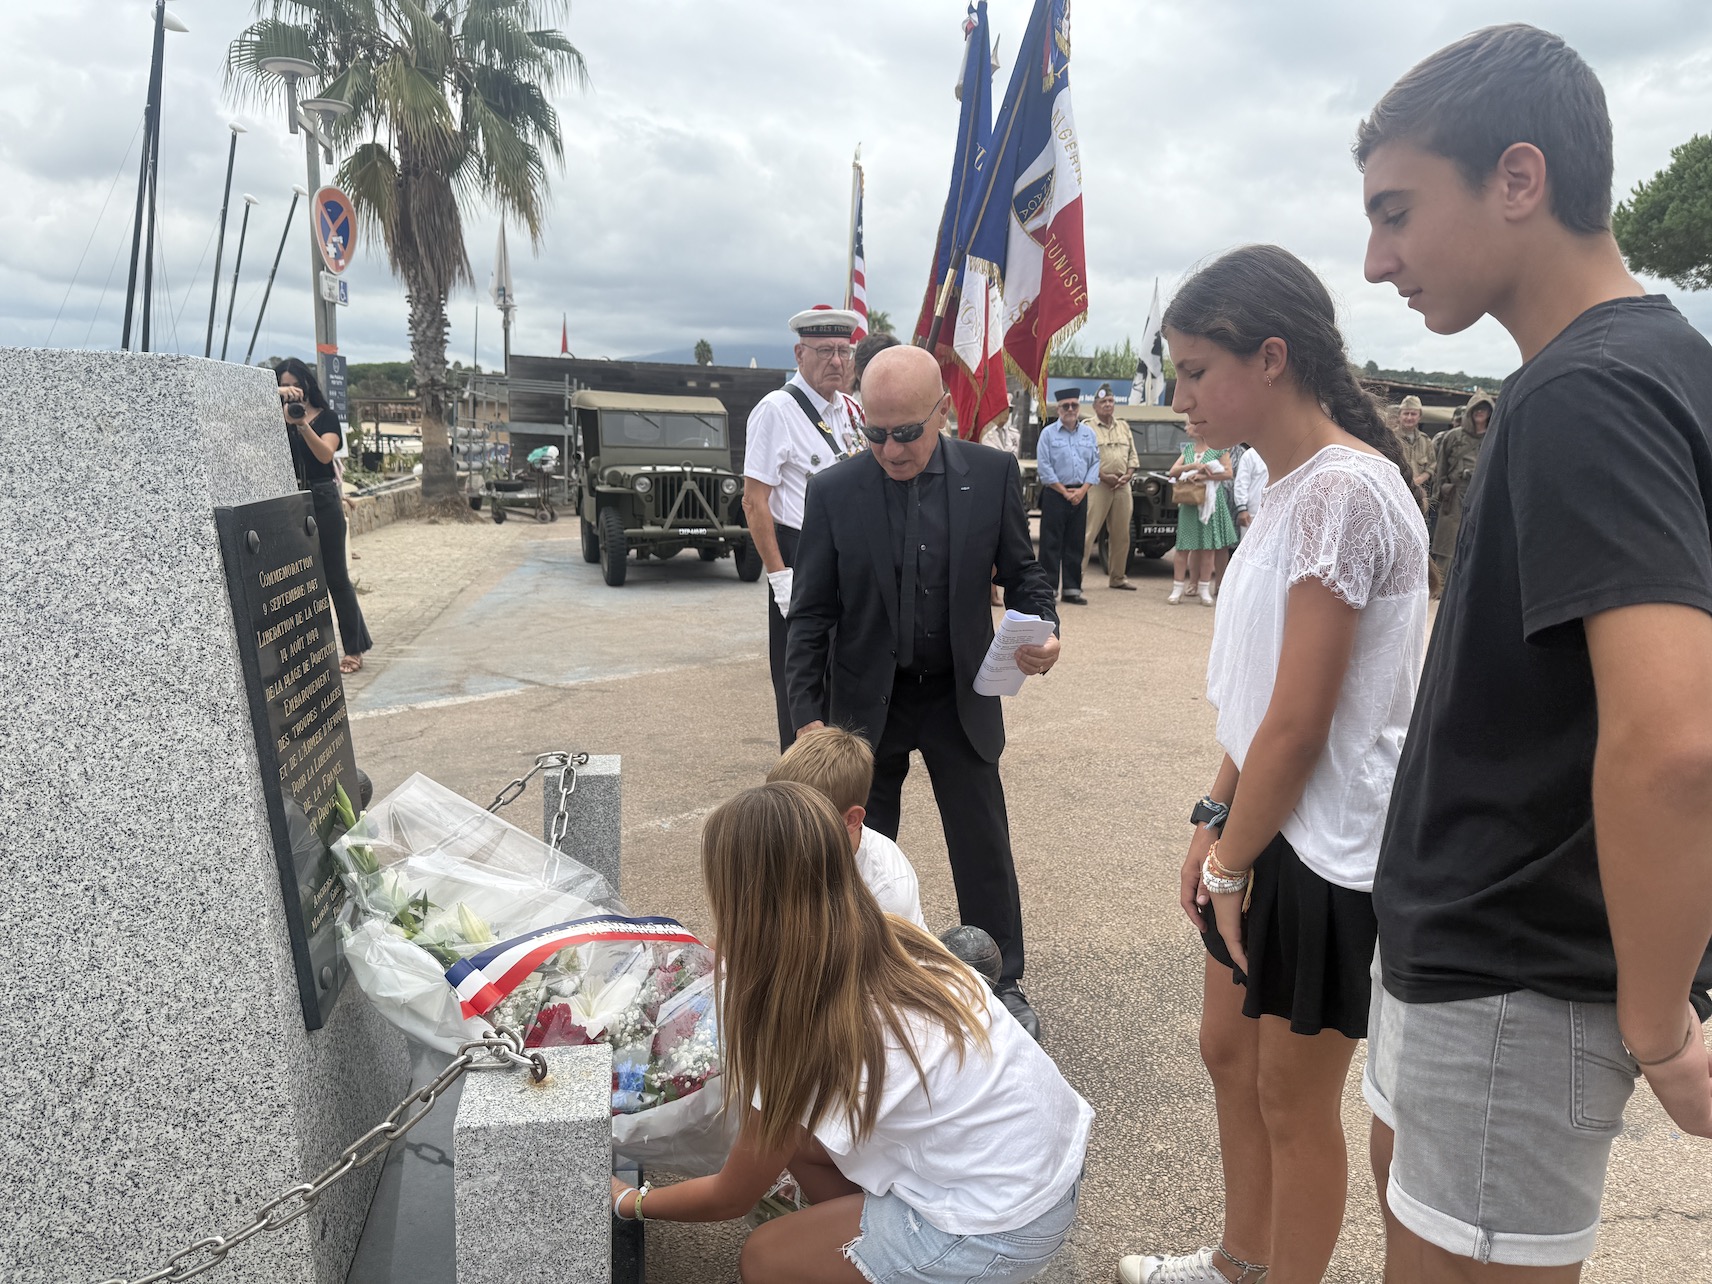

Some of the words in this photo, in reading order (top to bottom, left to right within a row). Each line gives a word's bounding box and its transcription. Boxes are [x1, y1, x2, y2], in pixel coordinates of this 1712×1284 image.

[1045, 233, 1087, 306] TUNISIE
[259, 555, 314, 588] COMMEMORATION
[262, 602, 268, 616] 9
[270, 584, 305, 613] SEPTEMBRE
[257, 615, 297, 649] LIBERATION
[295, 611, 304, 626] DE
[304, 605, 313, 620] LA
[265, 686, 275, 702] DE
[274, 680, 284, 696] LA
[283, 665, 302, 689] PLAGE
[302, 659, 311, 675] DE
[283, 669, 331, 718] EMBARQUEMENT
[277, 732, 290, 753] DES
[292, 706, 318, 739] TROUPES
[279, 763, 288, 781] ET
[289, 753, 298, 771] DE
[291, 773, 307, 798] POUR
[306, 765, 315, 781] LA
[313, 731, 345, 773] LIBERATION
[303, 796, 313, 815] DE
[313, 785, 322, 803] LA
[322, 759, 345, 790] FRANCE
[317, 793, 338, 825] PROVE
